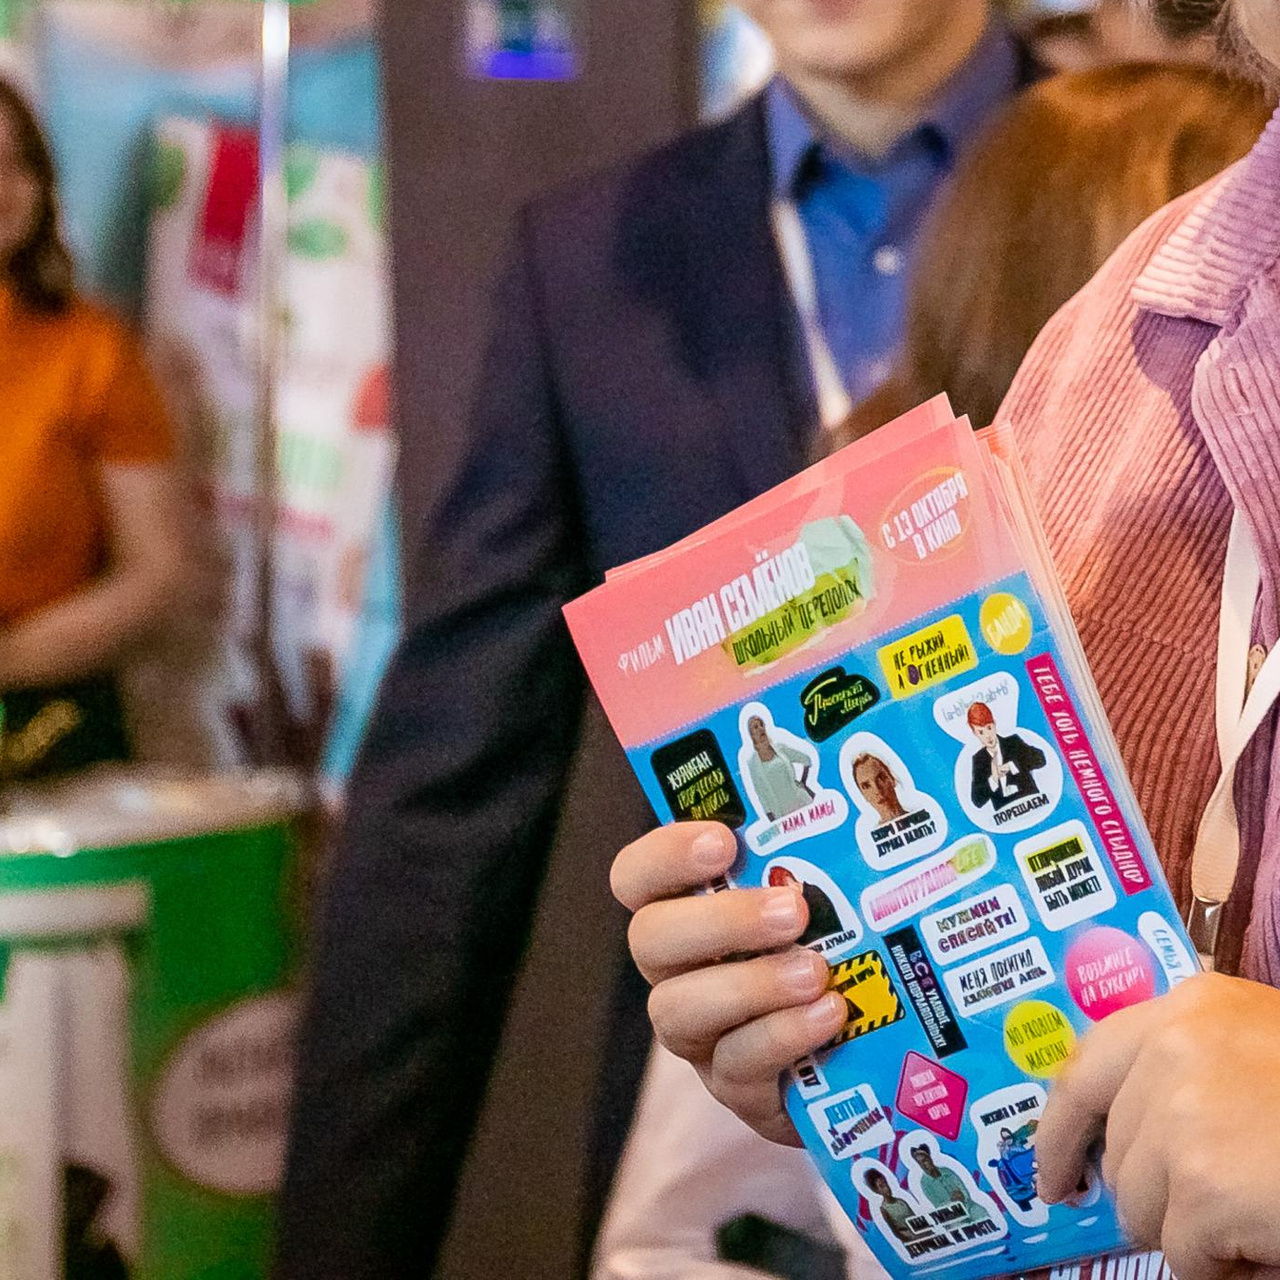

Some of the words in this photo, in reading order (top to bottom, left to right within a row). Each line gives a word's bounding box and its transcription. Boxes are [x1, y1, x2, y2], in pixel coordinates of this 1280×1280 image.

[881, 523, 896, 549] С
[893, 510, 915, 542] 13
[910, 472, 968, 528] ОКТЯБРЯ
[912, 533, 927, 560] В
[923, 509, 962, 552] КИНО
[664, 593, 727, 665] ИВАН
[719, 541, 816, 634] СЕМЁНОВ
[732, 607, 795, 665] ШКОЛЬНЫЙ
[799, 575, 863, 629] ПЕРЕПОЛОХ
[893, 650, 908, 671] НЕ
[898, 673, 905, 690] А
[907, 643, 970, 686] ОГНЕННЫЙ!
[666, 750, 714, 791] ХУЛИГАН
[1033, 667, 1064, 704] ТЕБЕ
[1052, 711, 1080, 746] ХОТЬ
[1069, 749, 1113, 816] НЕМНОГО
[1101, 819, 1145, 884] СТЫДНО?
[993, 793, 1050, 826] ПОРЕШАЕМ
[1065, 856, 1095, 882] ДУРАК
[936, 897, 1001, 933] МУЖИКИ
[1043, 891, 1070, 912] БЫТЬ
[824, 929, 857, 952] ДУМАЮ
[1153, 929, 1181, 970] СЕМЬЯ
[891, 944, 916, 981] НИКОГО
[959, 966, 988, 992] МЕНЯ
[989, 948, 1034, 980] ПОХИТИЛ
[1081, 985, 1097, 1007] НА
[1006, 1026, 1024, 1047] NO
[1022, 1010, 1065, 1040] PROBLEM
